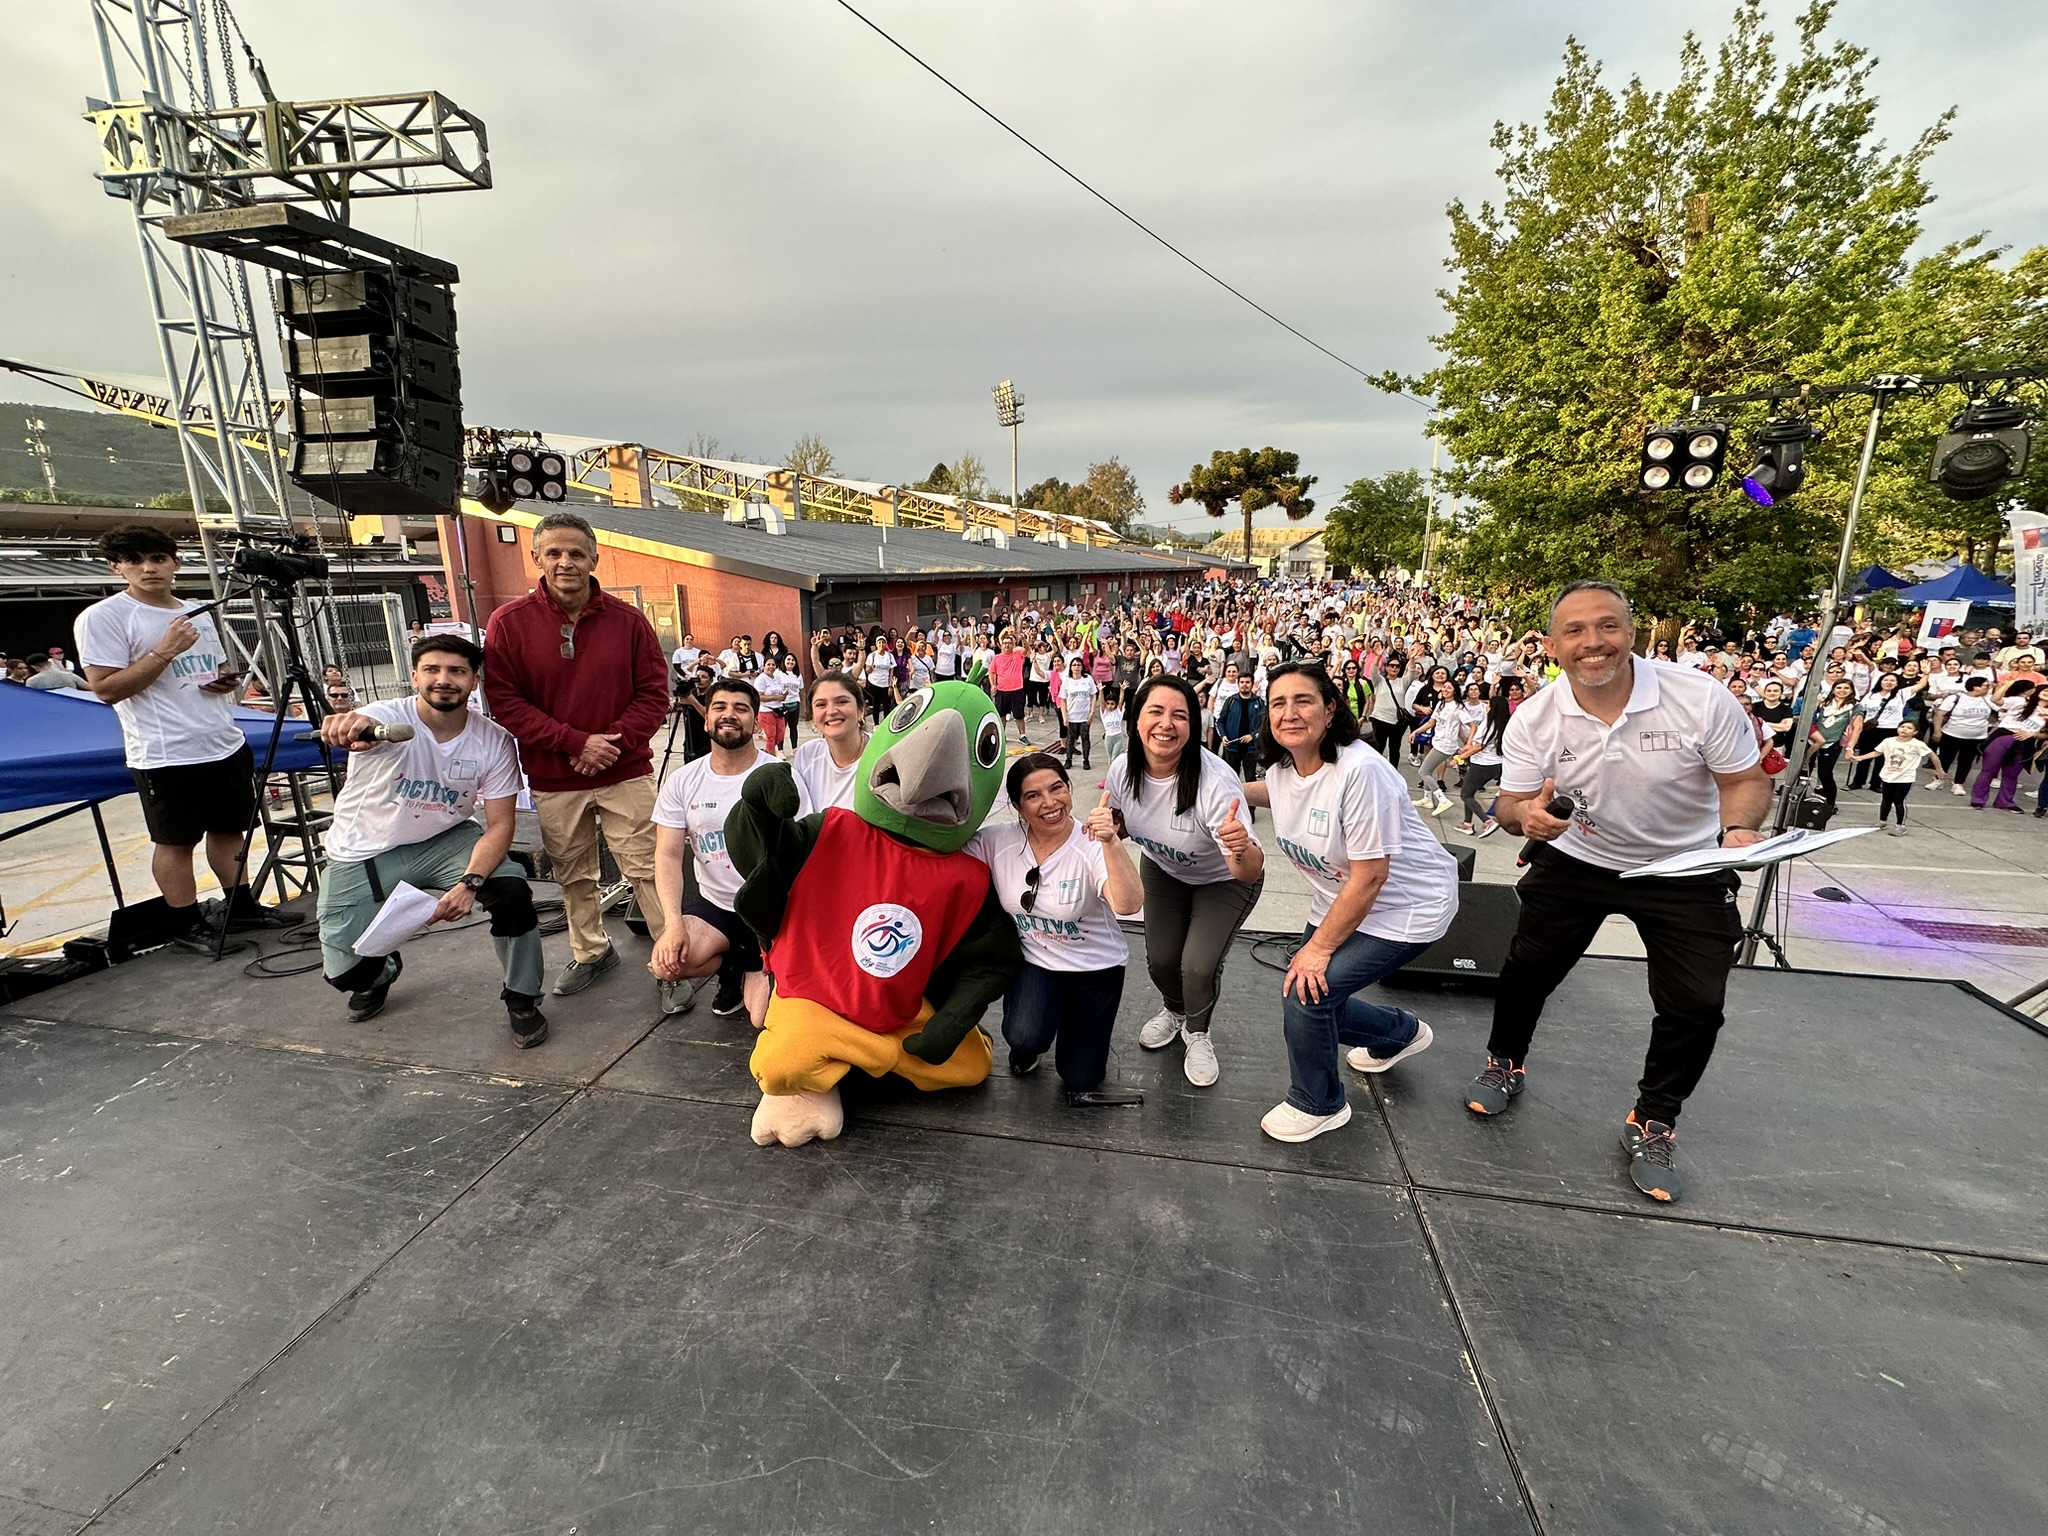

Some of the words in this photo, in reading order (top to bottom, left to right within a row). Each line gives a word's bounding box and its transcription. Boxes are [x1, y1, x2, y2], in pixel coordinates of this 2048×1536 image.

[171, 653, 218, 679] ACTIV
[698, 829, 726, 854] ACT
[1015, 913, 1080, 936] CTIVA
